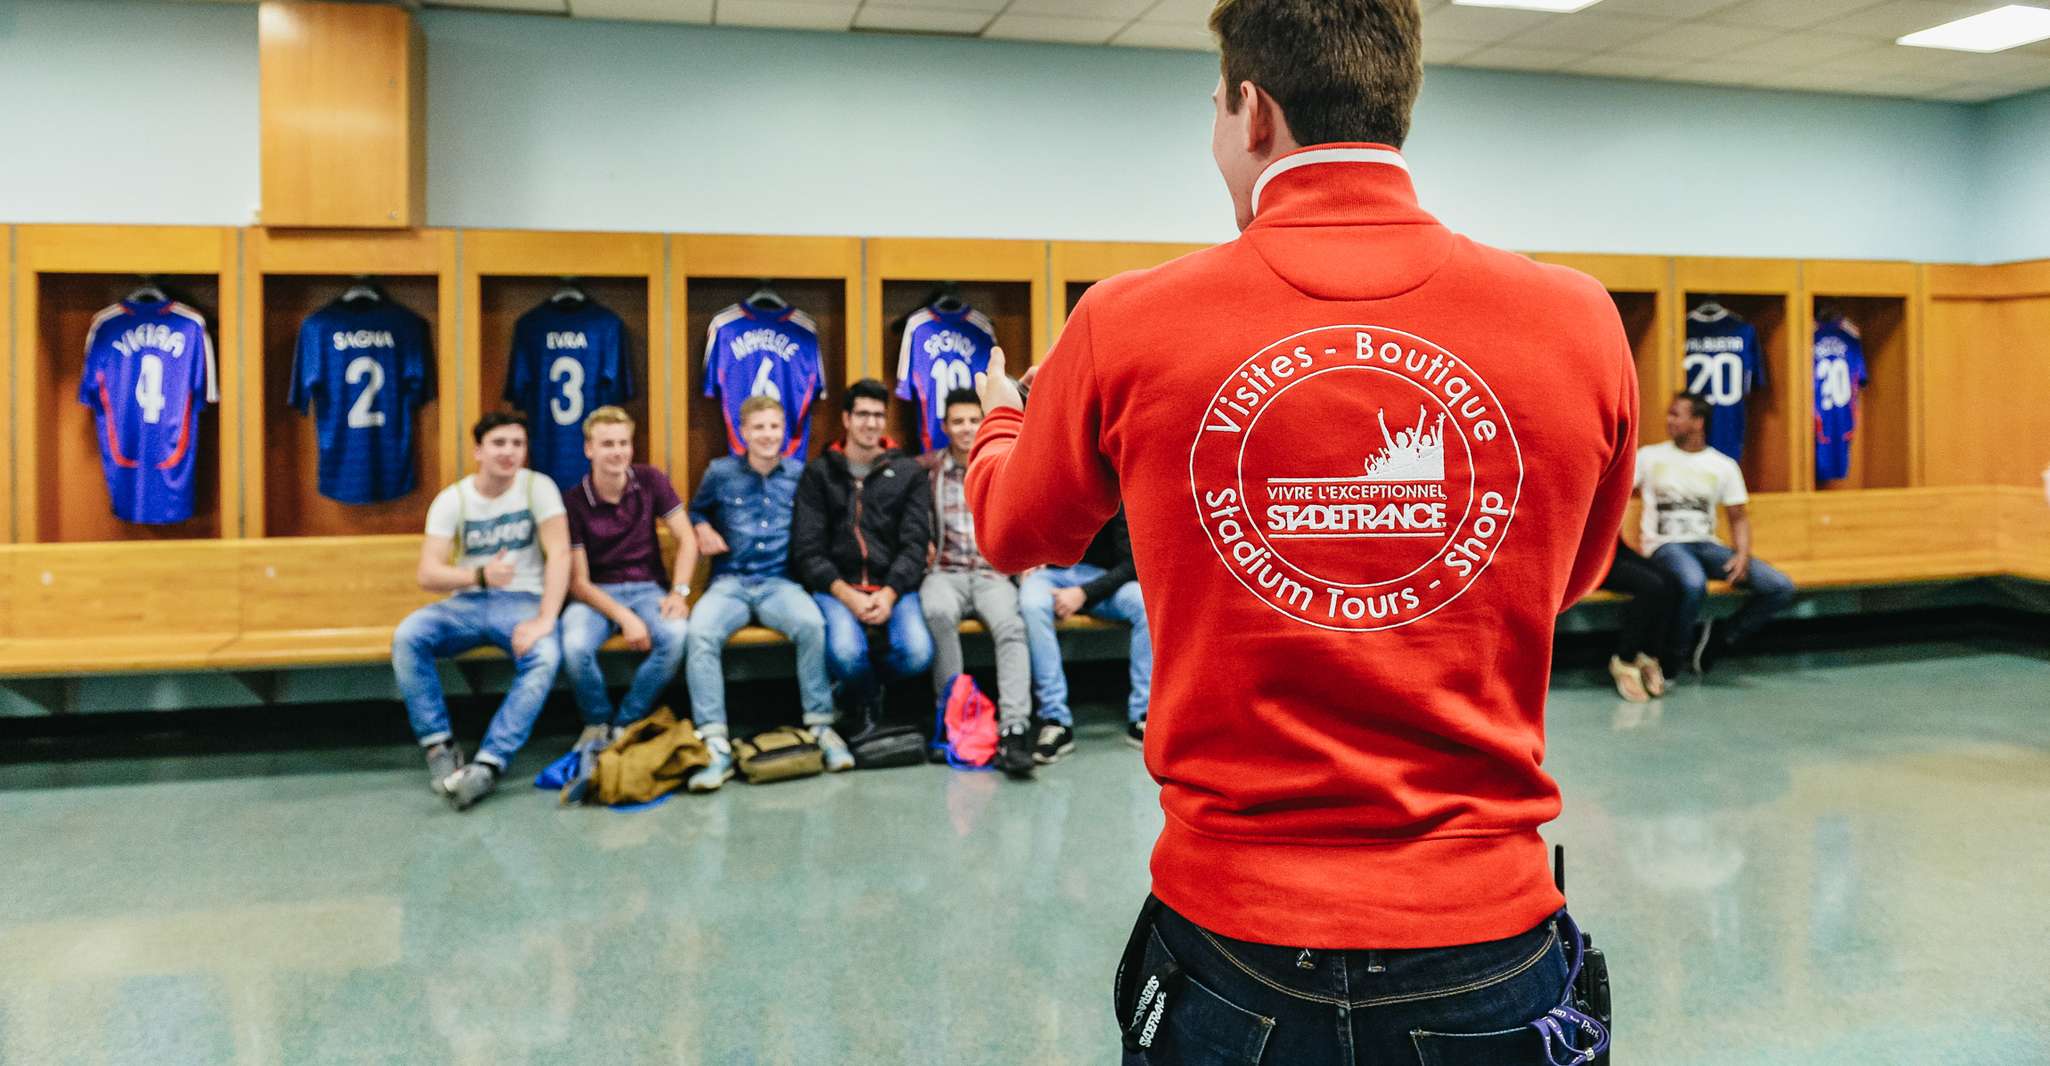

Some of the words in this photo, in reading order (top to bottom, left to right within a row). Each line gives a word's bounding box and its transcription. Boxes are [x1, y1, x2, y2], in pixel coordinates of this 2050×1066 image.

[333, 330, 395, 351] SAGNA
[546, 331, 588, 350] EVRA
[135, 353, 165, 424] 4
[345, 356, 386, 429] 2
[549, 356, 585, 426] 3
[1205, 345, 1313, 435] Visites
[1355, 331, 1497, 442] Boutique
[1683, 352, 1743, 406] 20
[1266, 503, 1447, 530] STADEFRANCE
[1267, 486, 1313, 500] VIVRE
[1318, 484, 1447, 500] L'EXCEPTIONNEL
[1205, 487, 1314, 612] Stadium
[1327, 586, 1420, 620] Tours
[1444, 490, 1509, 578] Shop
